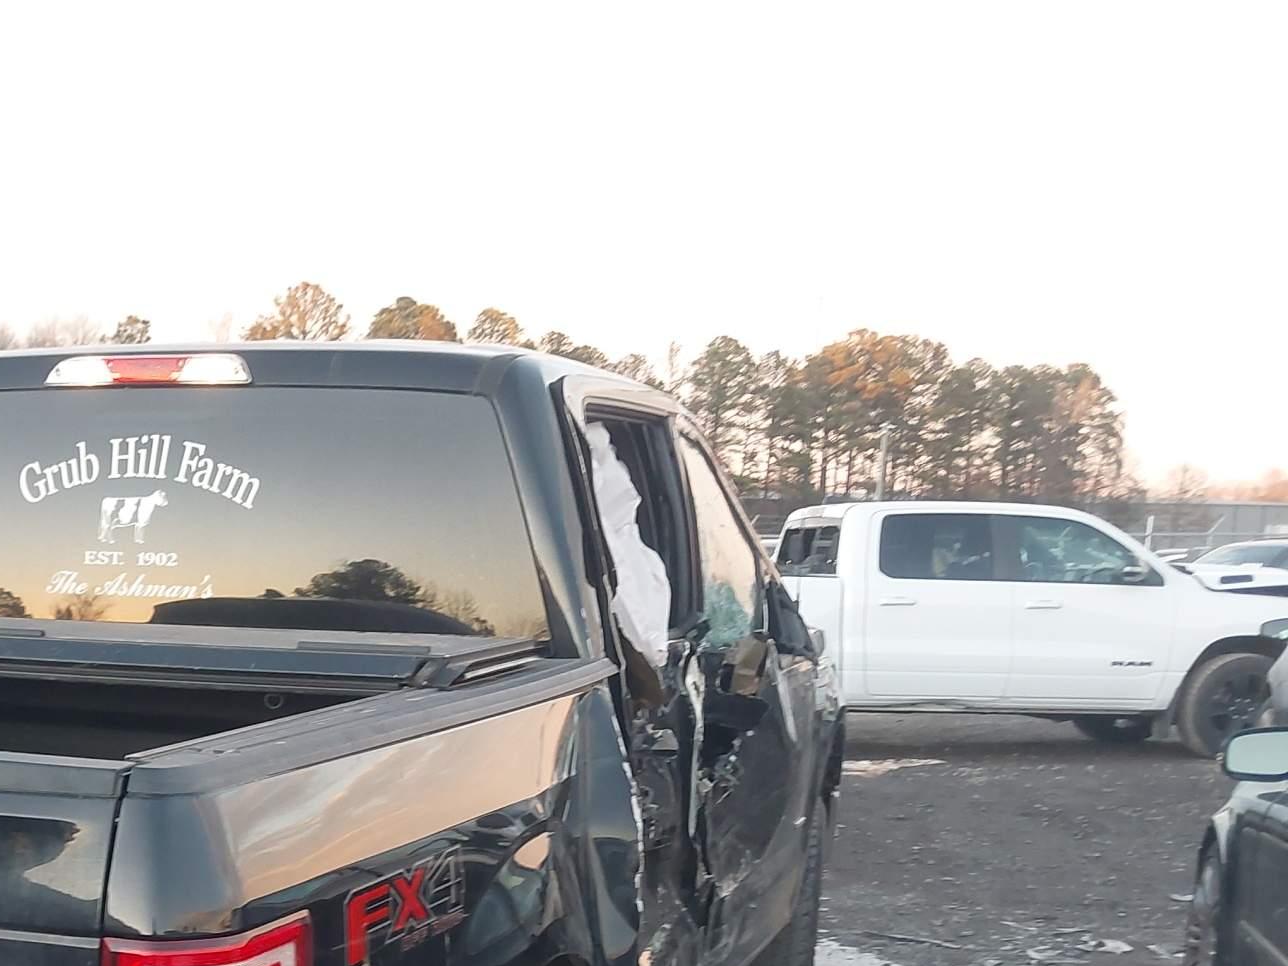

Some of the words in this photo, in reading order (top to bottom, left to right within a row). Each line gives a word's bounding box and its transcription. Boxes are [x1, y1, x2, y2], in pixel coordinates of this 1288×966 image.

[19, 441, 100, 504] Grub
[107, 434, 172, 480] Hill
[173, 440, 261, 510] Farm
[83, 551, 125, 565] EST.
[135, 551, 179, 567] 1902
[45, 570, 89, 595] The
[94, 573, 214, 600] Ashman's
